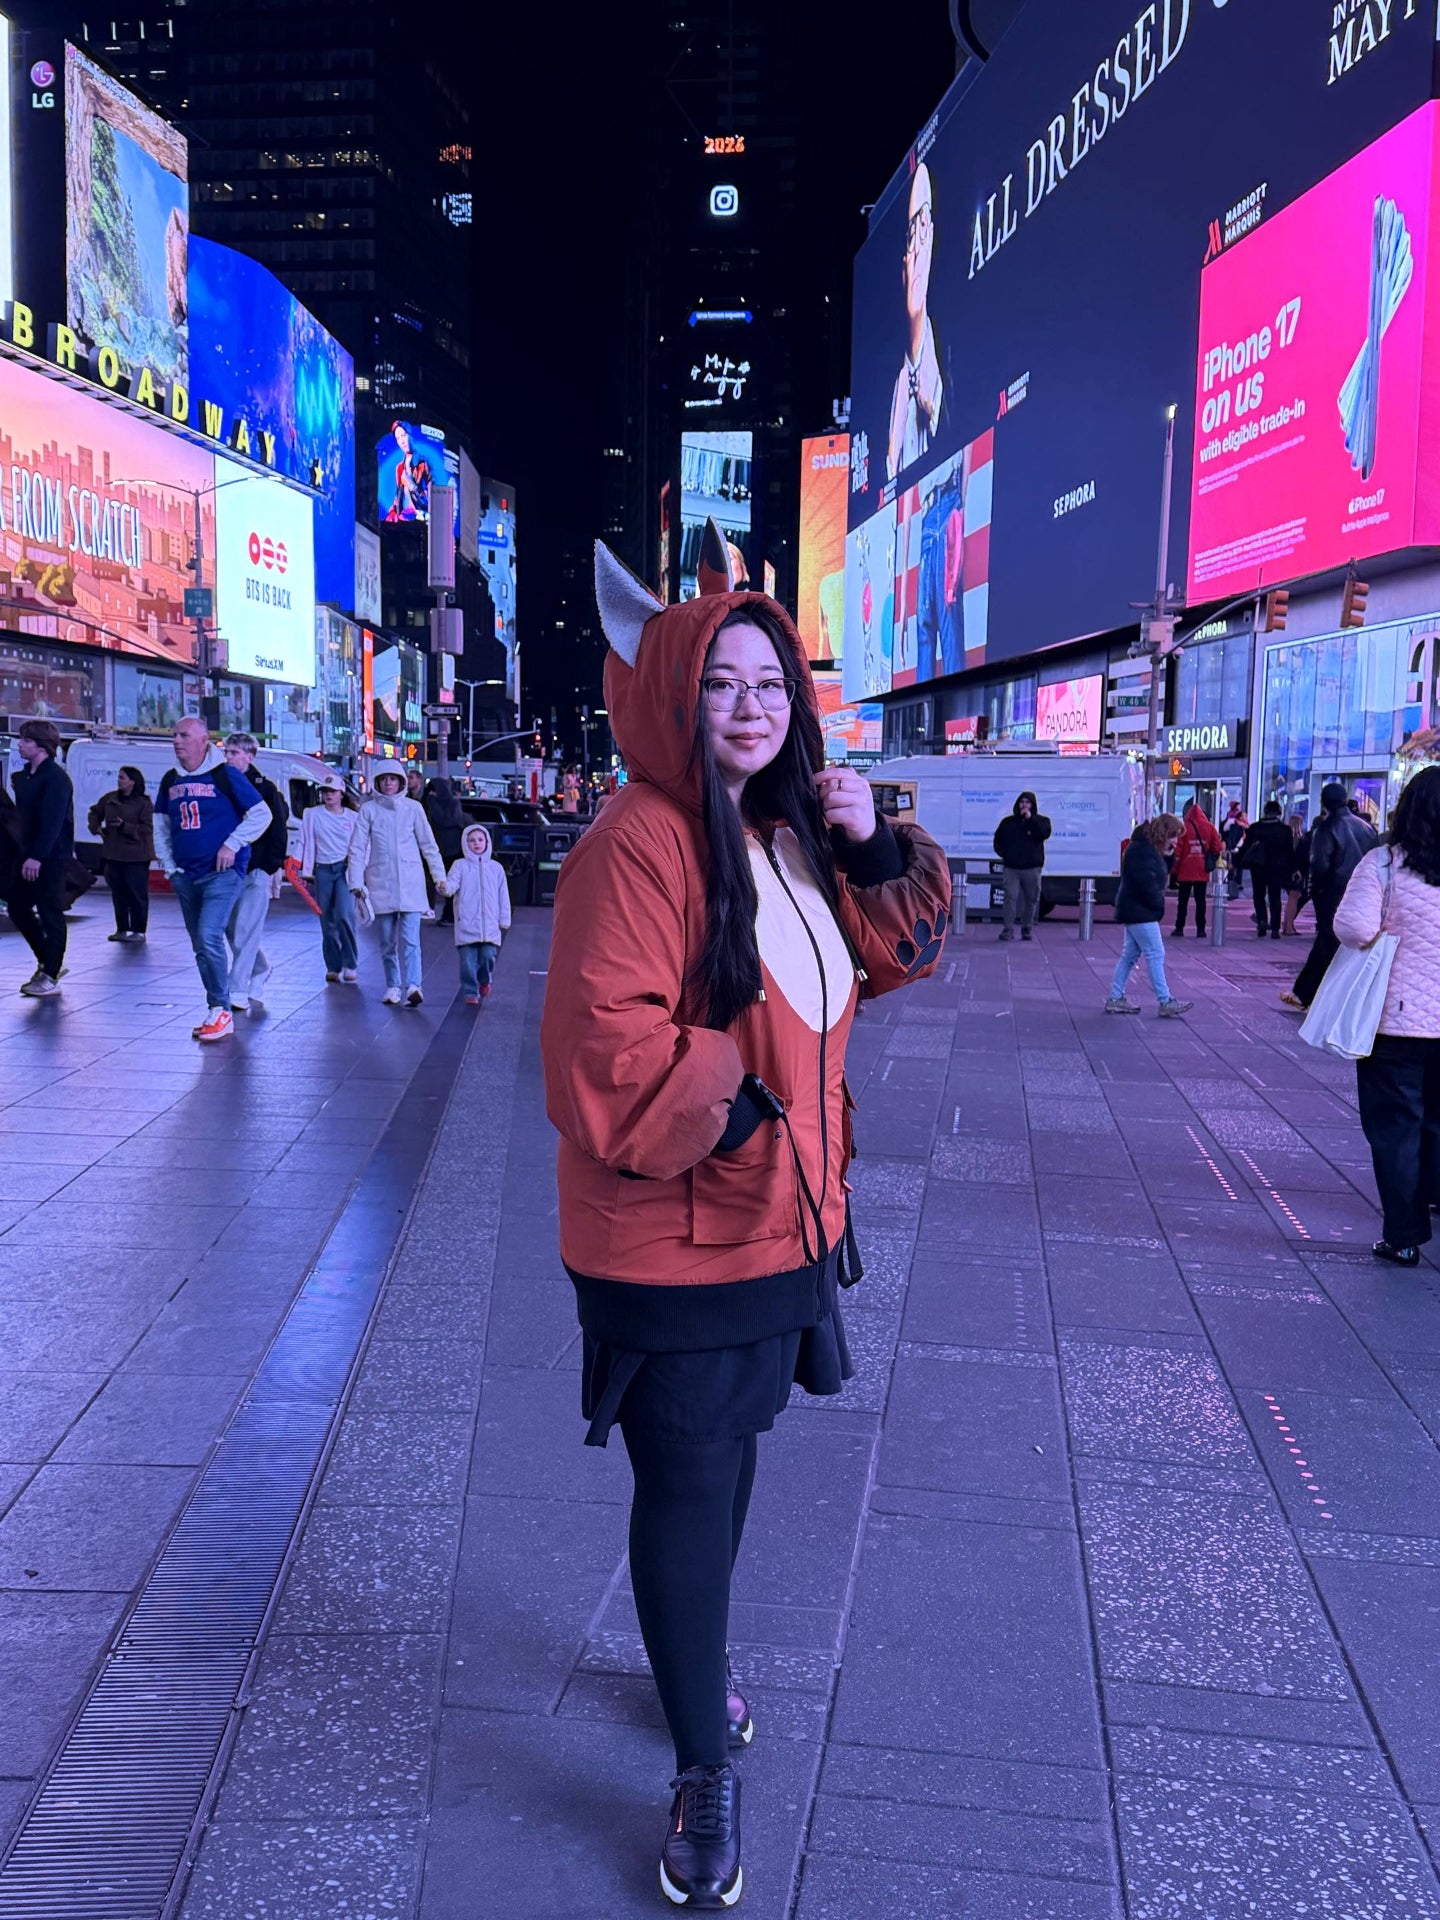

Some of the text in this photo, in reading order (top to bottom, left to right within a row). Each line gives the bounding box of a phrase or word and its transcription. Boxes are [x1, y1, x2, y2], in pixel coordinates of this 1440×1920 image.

[1327, 0, 1392, 86] MAY
[32, 92, 55, 108] LG
[704, 136, 746, 154] 2026
[968, 0, 1190, 280] ALL DRESSED
[1225, 182, 1267, 226] MARRIOTT
[1224, 205, 1262, 244] MARQUIS
[1203, 295, 1301, 392] iPhone 17
[12, 300, 276, 465] BROADWAY
[1007, 386, 1027, 411] MARQUIS
[1008, 371, 1030, 396] MARRIOTT
[1201, 371, 1265, 433] on us
[1200, 397, 1306, 463] with eligible trade-in
[1053, 480, 1096, 518] SEPHORA
[11, 464, 63, 549] FROM
[68, 484, 142, 570] SCRATCH
[246, 577, 292, 611] BTS IS BACK
[1193, 620, 1228, 641] SEPHORA
[255, 654, 284, 672] SiriusXM
[1119, 697, 1127, 707] W
[1045, 709, 1088, 735] PANDORA
[1168, 724, 1229, 753] SEPHORA
[180, 800, 201, 830] 11
